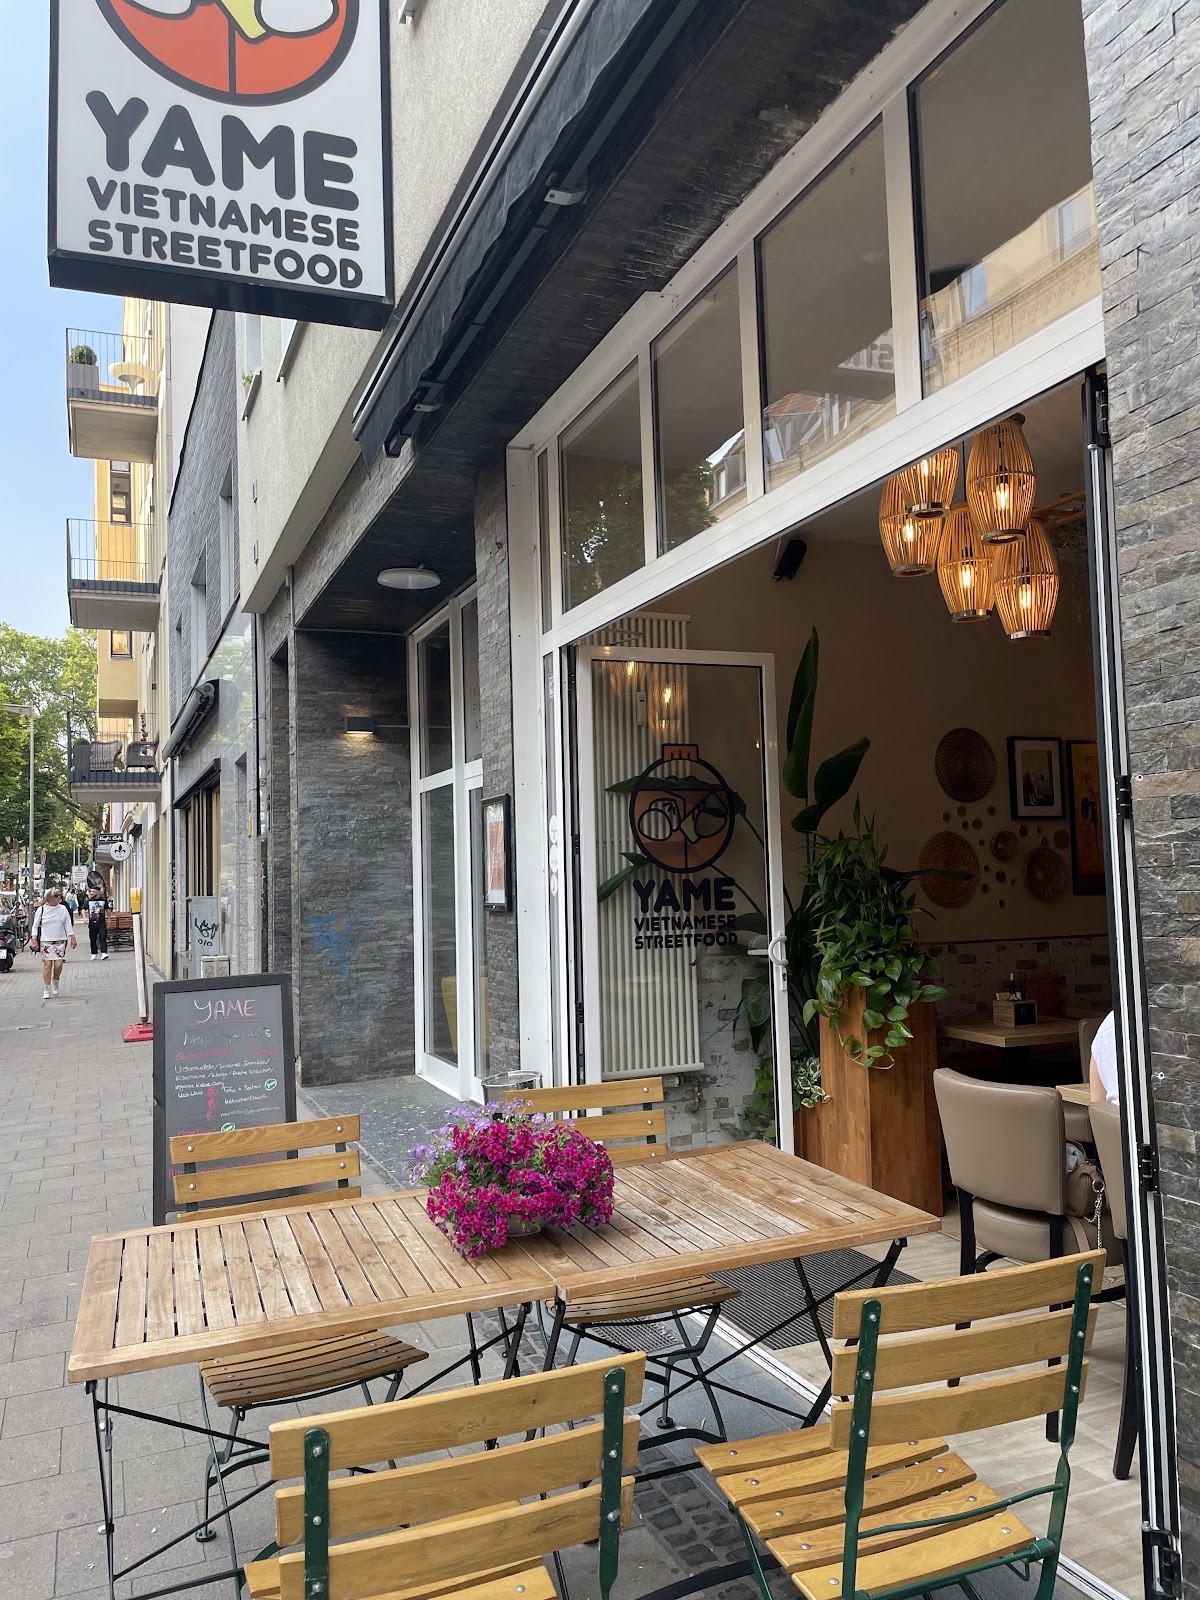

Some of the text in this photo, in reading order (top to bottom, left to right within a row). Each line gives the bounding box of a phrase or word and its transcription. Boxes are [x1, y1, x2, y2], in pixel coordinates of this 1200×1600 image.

[85, 90, 359, 211] YAME
[86, 176, 360, 252] VIETNAMESE
[87, 219, 363, 289] STREETFOOD
[632, 877, 736, 913] YAME
[634, 914, 737, 932] VIETNAMESE
[634, 932, 738, 950] STREETFOOD
[193, 999, 256, 1023] YAME
